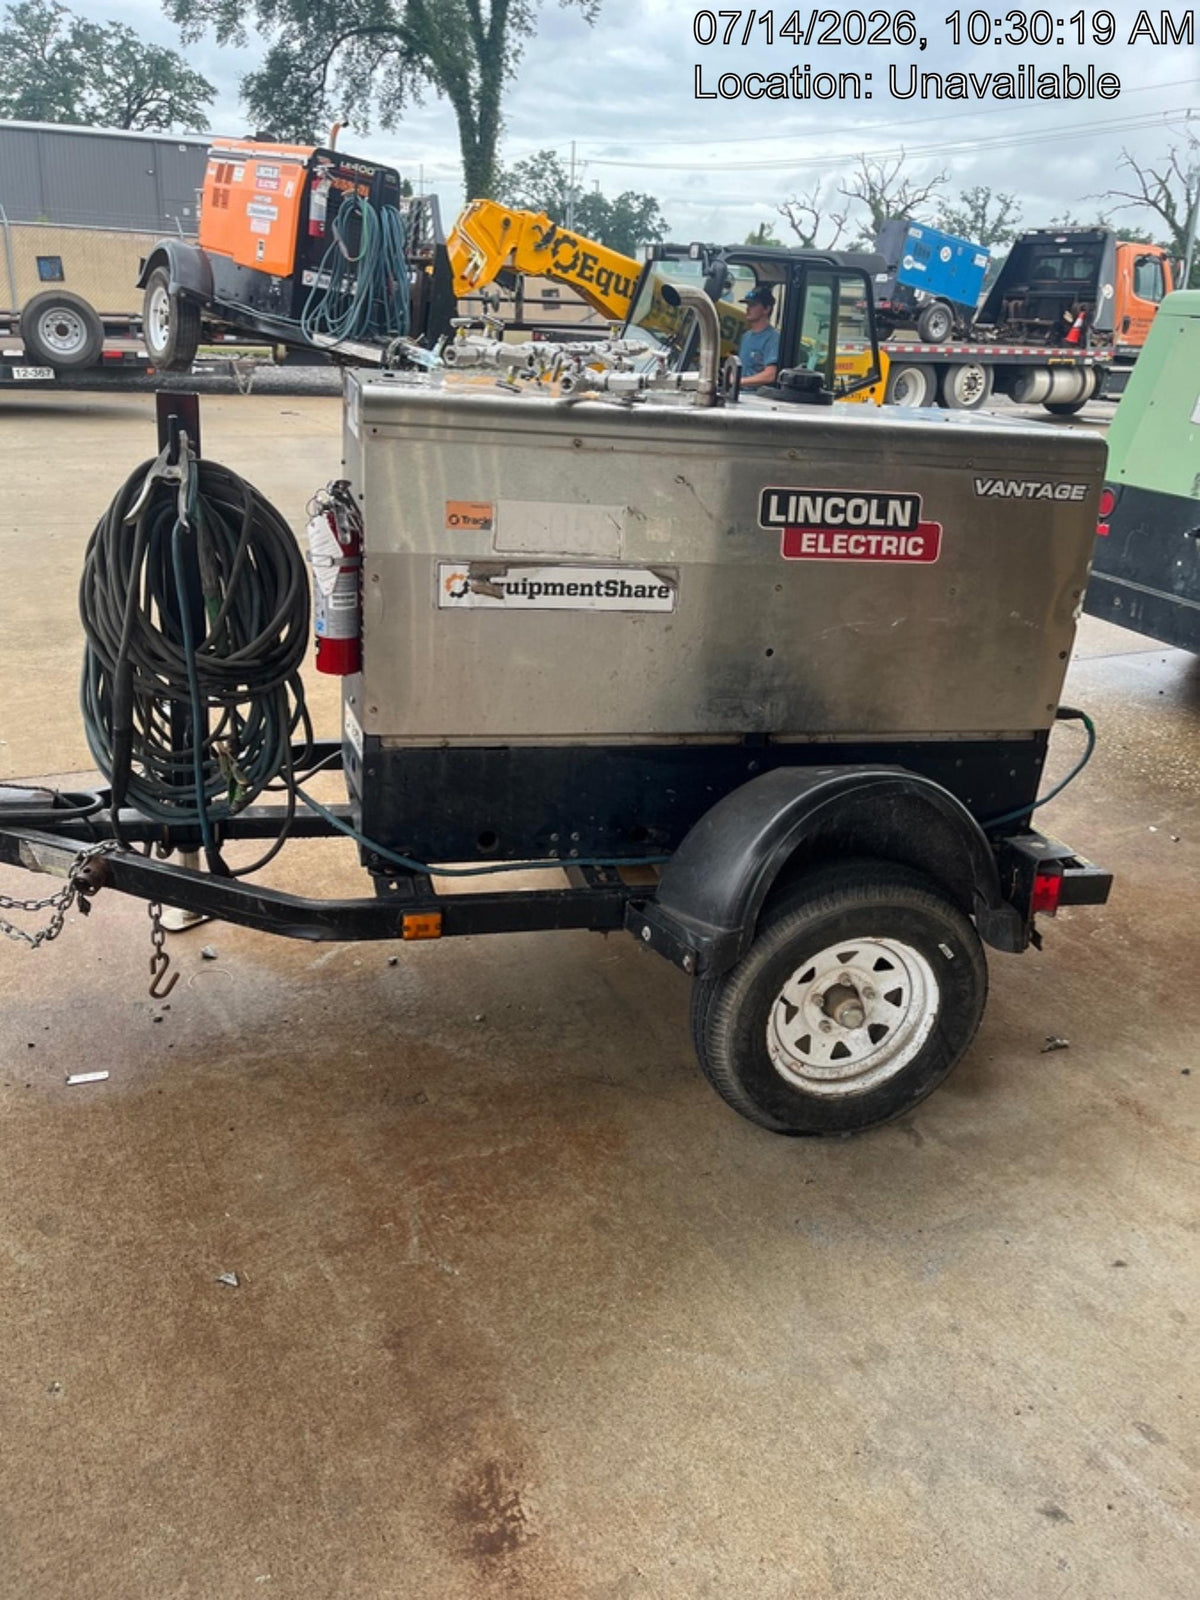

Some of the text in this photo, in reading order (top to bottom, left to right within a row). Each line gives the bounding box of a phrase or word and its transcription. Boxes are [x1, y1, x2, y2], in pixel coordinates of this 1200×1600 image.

[974, 479, 1087, 502] VANTAGE
[769, 496, 912, 527] LINCOLN
[801, 533, 926, 557] ELECTRIC
[500, 577, 671, 601] uipmentShare
